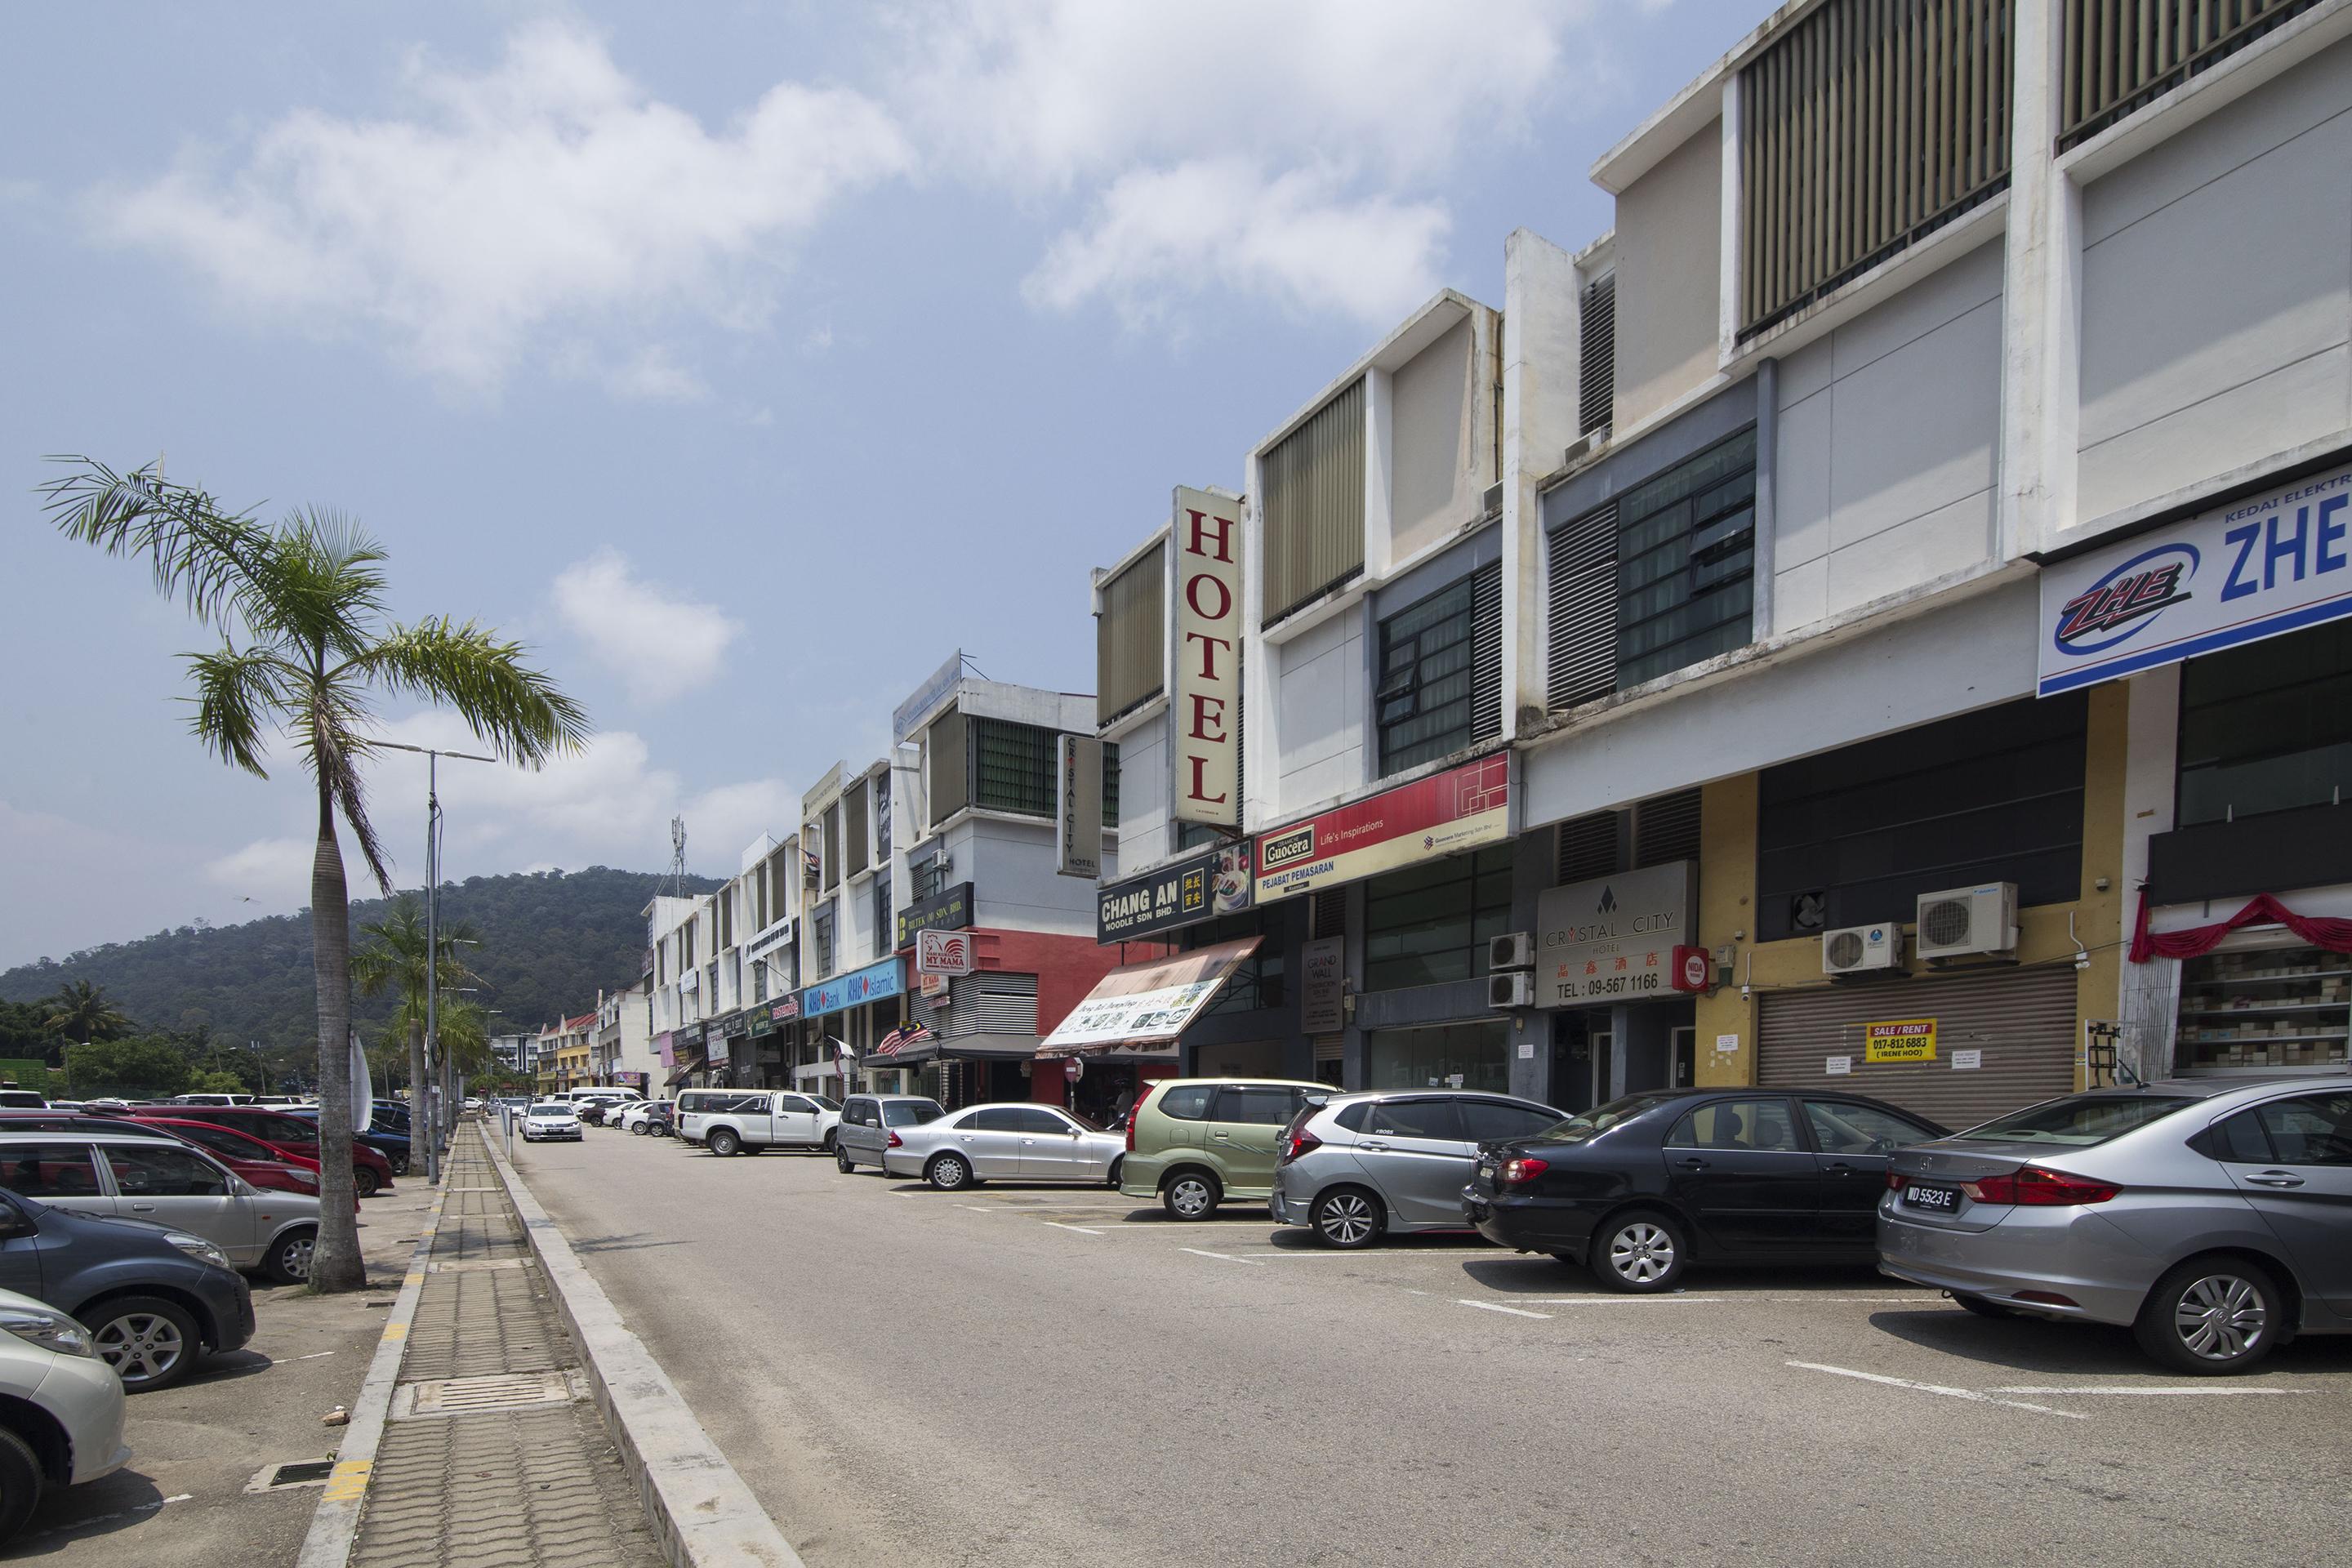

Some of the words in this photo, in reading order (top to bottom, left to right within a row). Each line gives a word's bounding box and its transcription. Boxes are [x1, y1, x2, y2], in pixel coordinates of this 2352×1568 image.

[2225, 497, 2279, 524] KEDAI
[2220, 492, 2350, 604] ZHE
[2059, 561, 2185, 644] ZHE
[1185, 507, 1234, 804] HOTEL
[1067, 737, 1076, 808] CRYSTAL
[1066, 813, 1075, 853] CITY
[1320, 833, 1339, 846] Life's
[1340, 819, 1384, 840] Inspirations
[1069, 858, 1095, 868] HOTEL
[1267, 838, 1309, 862] Guocera
[1262, 873, 1290, 890] PEJABAT
[1291, 861, 1334, 881] PEMASARAN
[1102, 889, 1150, 923] CHANG
[1156, 880, 1178, 906] AN
[1105, 916, 1134, 932] NOODLE
[1137, 911, 1153, 923] SDN
[1546, 921, 1618, 947] CRYSTAL
[1633, 911, 1673, 933] CITY
[926, 956, 938, 964] MY
[939, 957, 964, 966] MAMA
[1592, 944, 1620, 955] HOTEL
[1312, 967, 1331, 979] WALL
[1687, 961, 1704, 974] NIDA
[808, 989, 821, 1013] RHB
[826, 988, 840, 1009] Bank
[848, 975, 862, 1002] RHB
[869, 972, 893, 997] Islamic
[1557, 982, 1579, 1000] TEL
[1588, 978, 1626, 995] 09-567
[1631, 973, 1658, 990] 1166
[1873, 1038, 1904, 1049] 017-812
[1906, 1037, 1927, 1048] 6883
[1874, 1026, 1895, 1036] SALE
[1902, 1024, 1928, 1034] RENT
[1919, 1188, 1944, 1205] 5523
[1944, 1192, 1953, 1206] E
